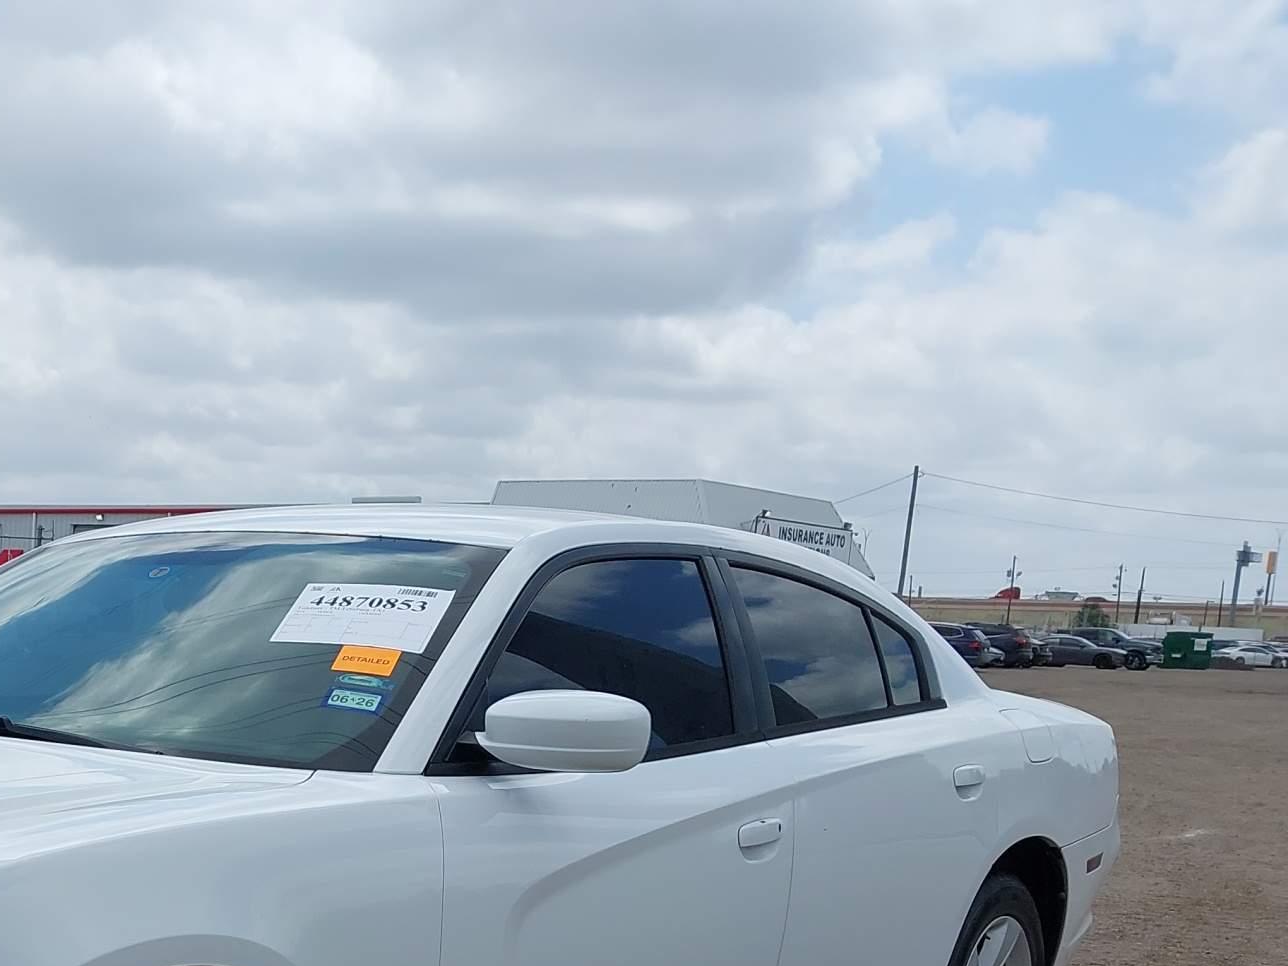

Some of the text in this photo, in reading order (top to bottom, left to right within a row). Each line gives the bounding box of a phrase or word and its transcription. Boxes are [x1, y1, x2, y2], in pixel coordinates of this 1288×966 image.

[778, 526, 825, 545] INSURANCE
[825, 532, 846, 548] AUTO
[310, 595, 428, 612] 44870853
[342, 655, 390, 665] DETAILED
